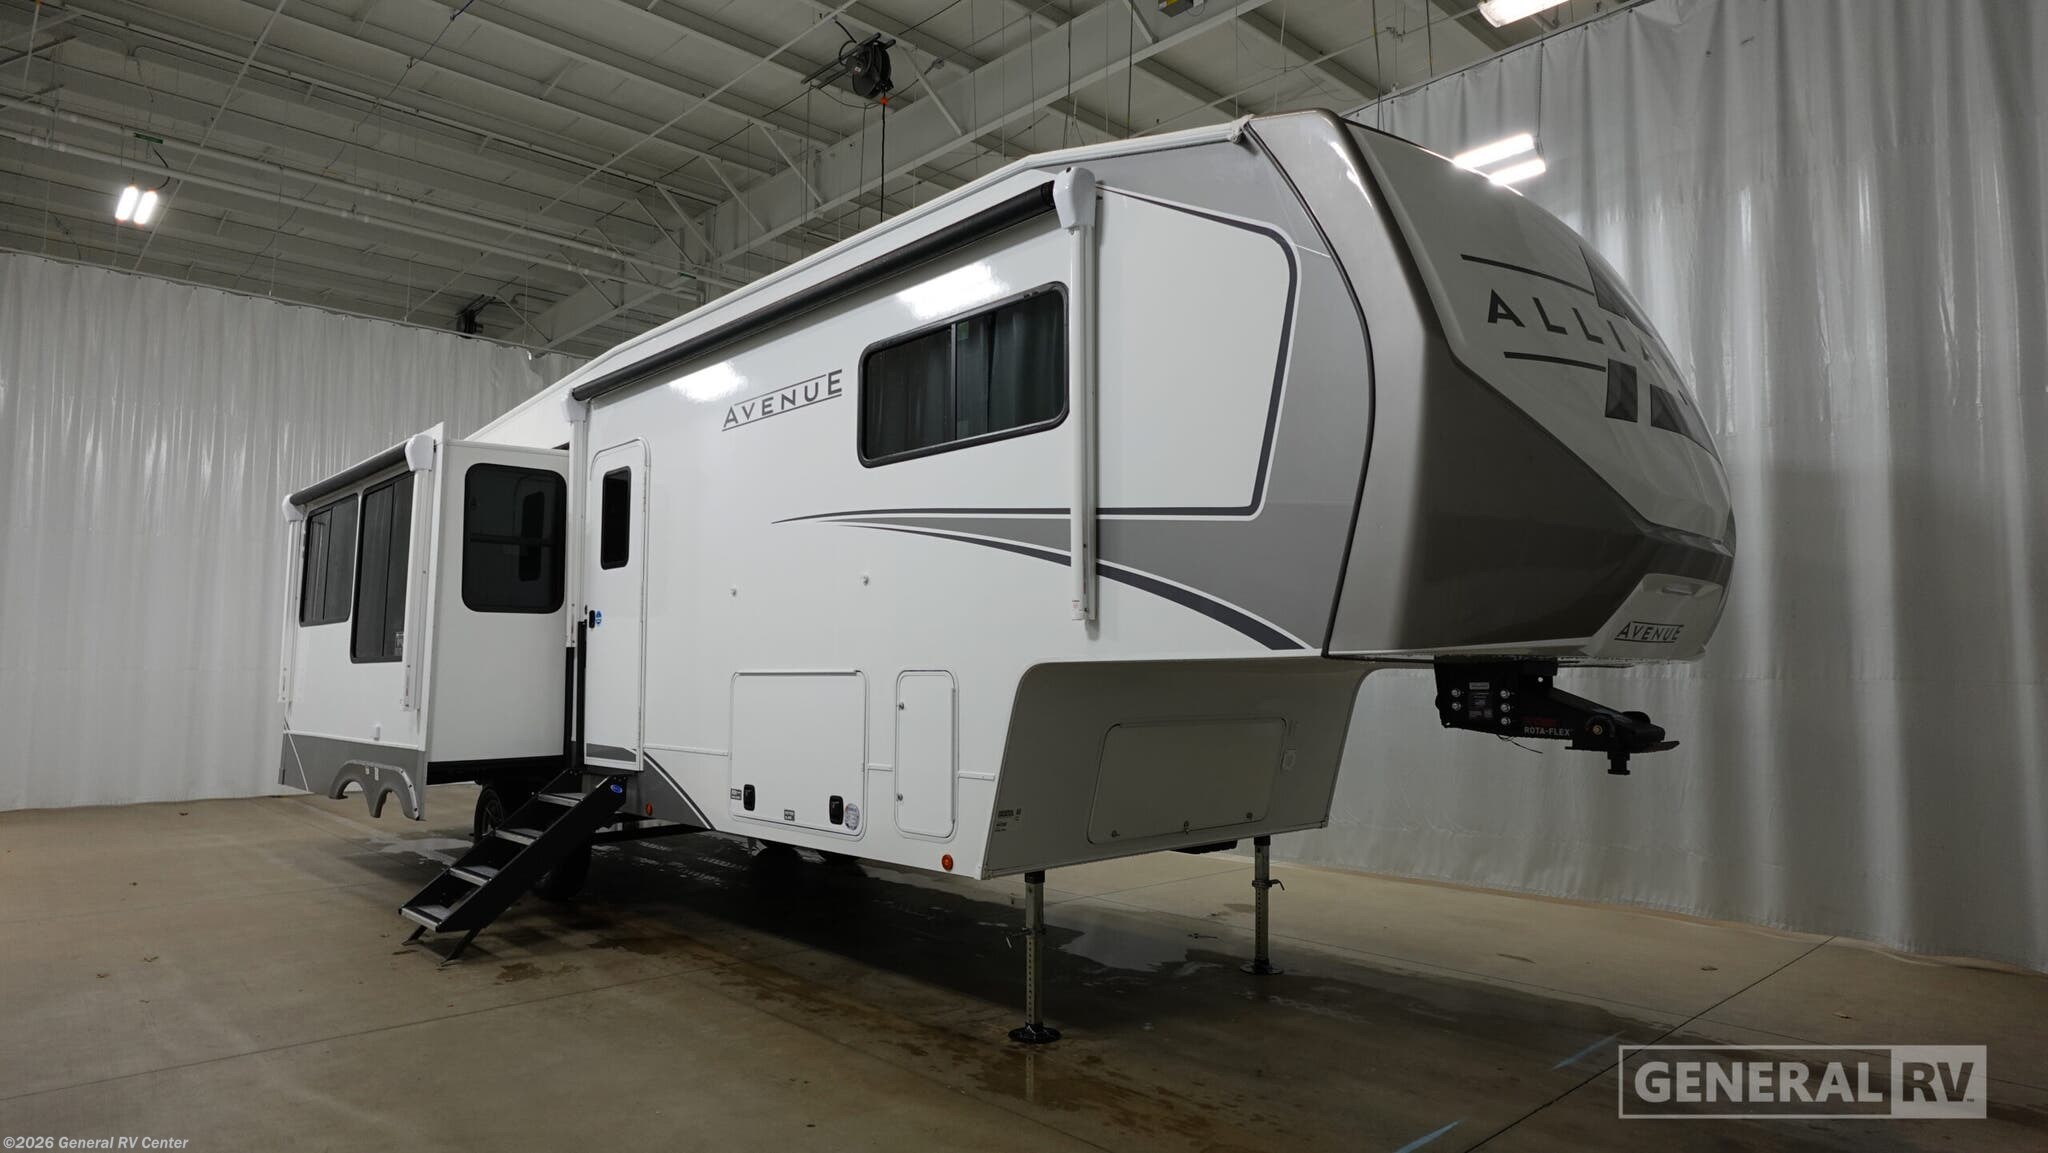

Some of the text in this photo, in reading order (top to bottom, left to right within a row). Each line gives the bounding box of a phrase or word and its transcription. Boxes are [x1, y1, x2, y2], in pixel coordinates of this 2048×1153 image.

[723, 369, 842, 429] AVENUE
[1616, 622, 1683, 642] AVENUE
[1523, 726, 1571, 737] ROTA-FLEX
